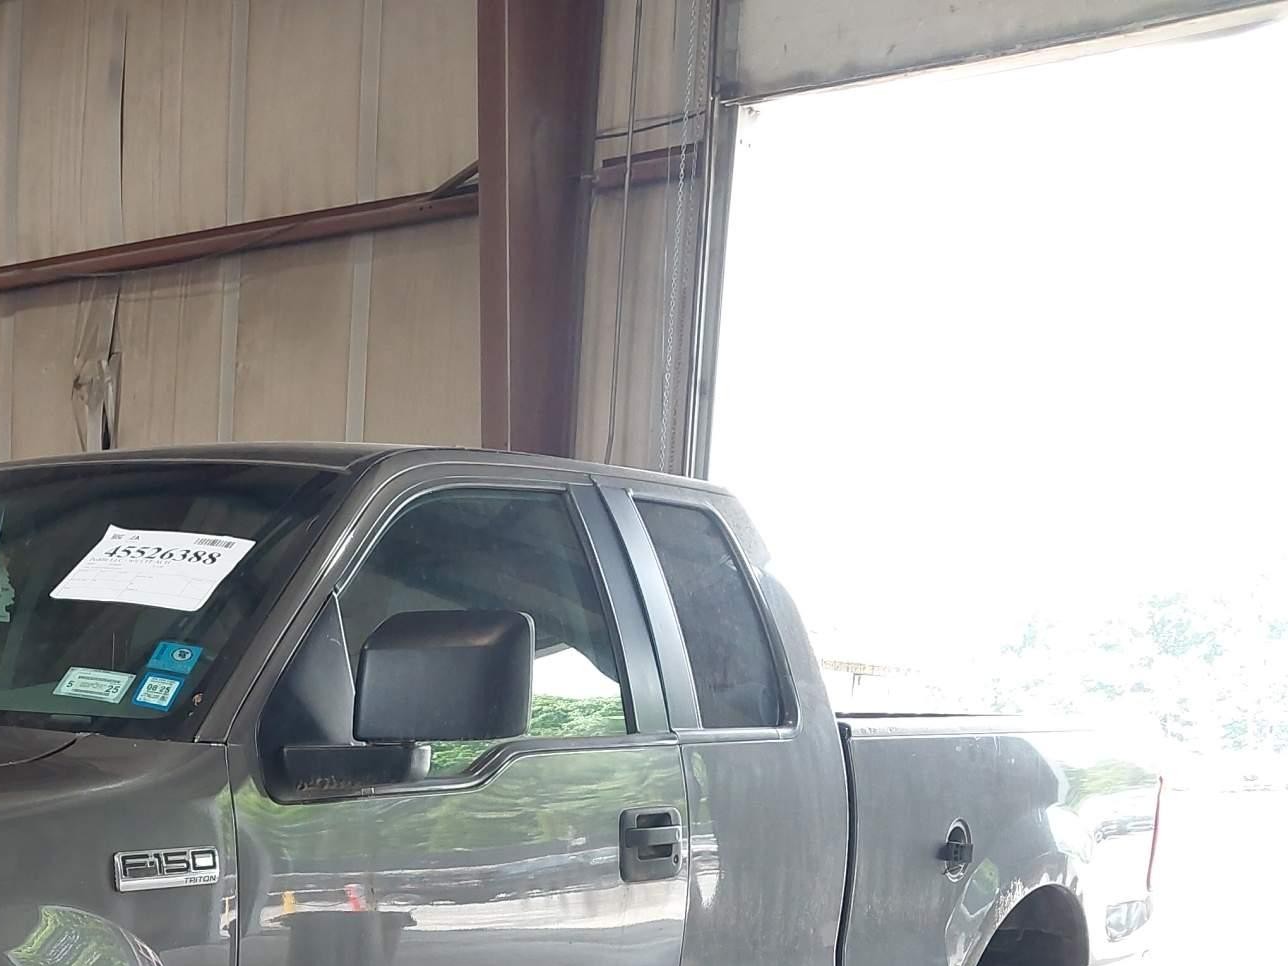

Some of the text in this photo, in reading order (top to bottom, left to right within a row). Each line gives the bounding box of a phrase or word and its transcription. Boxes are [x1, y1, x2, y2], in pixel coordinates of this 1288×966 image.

[104, 544, 222, 566] 45526388
[104, 685, 121, 694] 25
[159, 685, 171, 693] 25
[183, 874, 217, 884] TRITON
